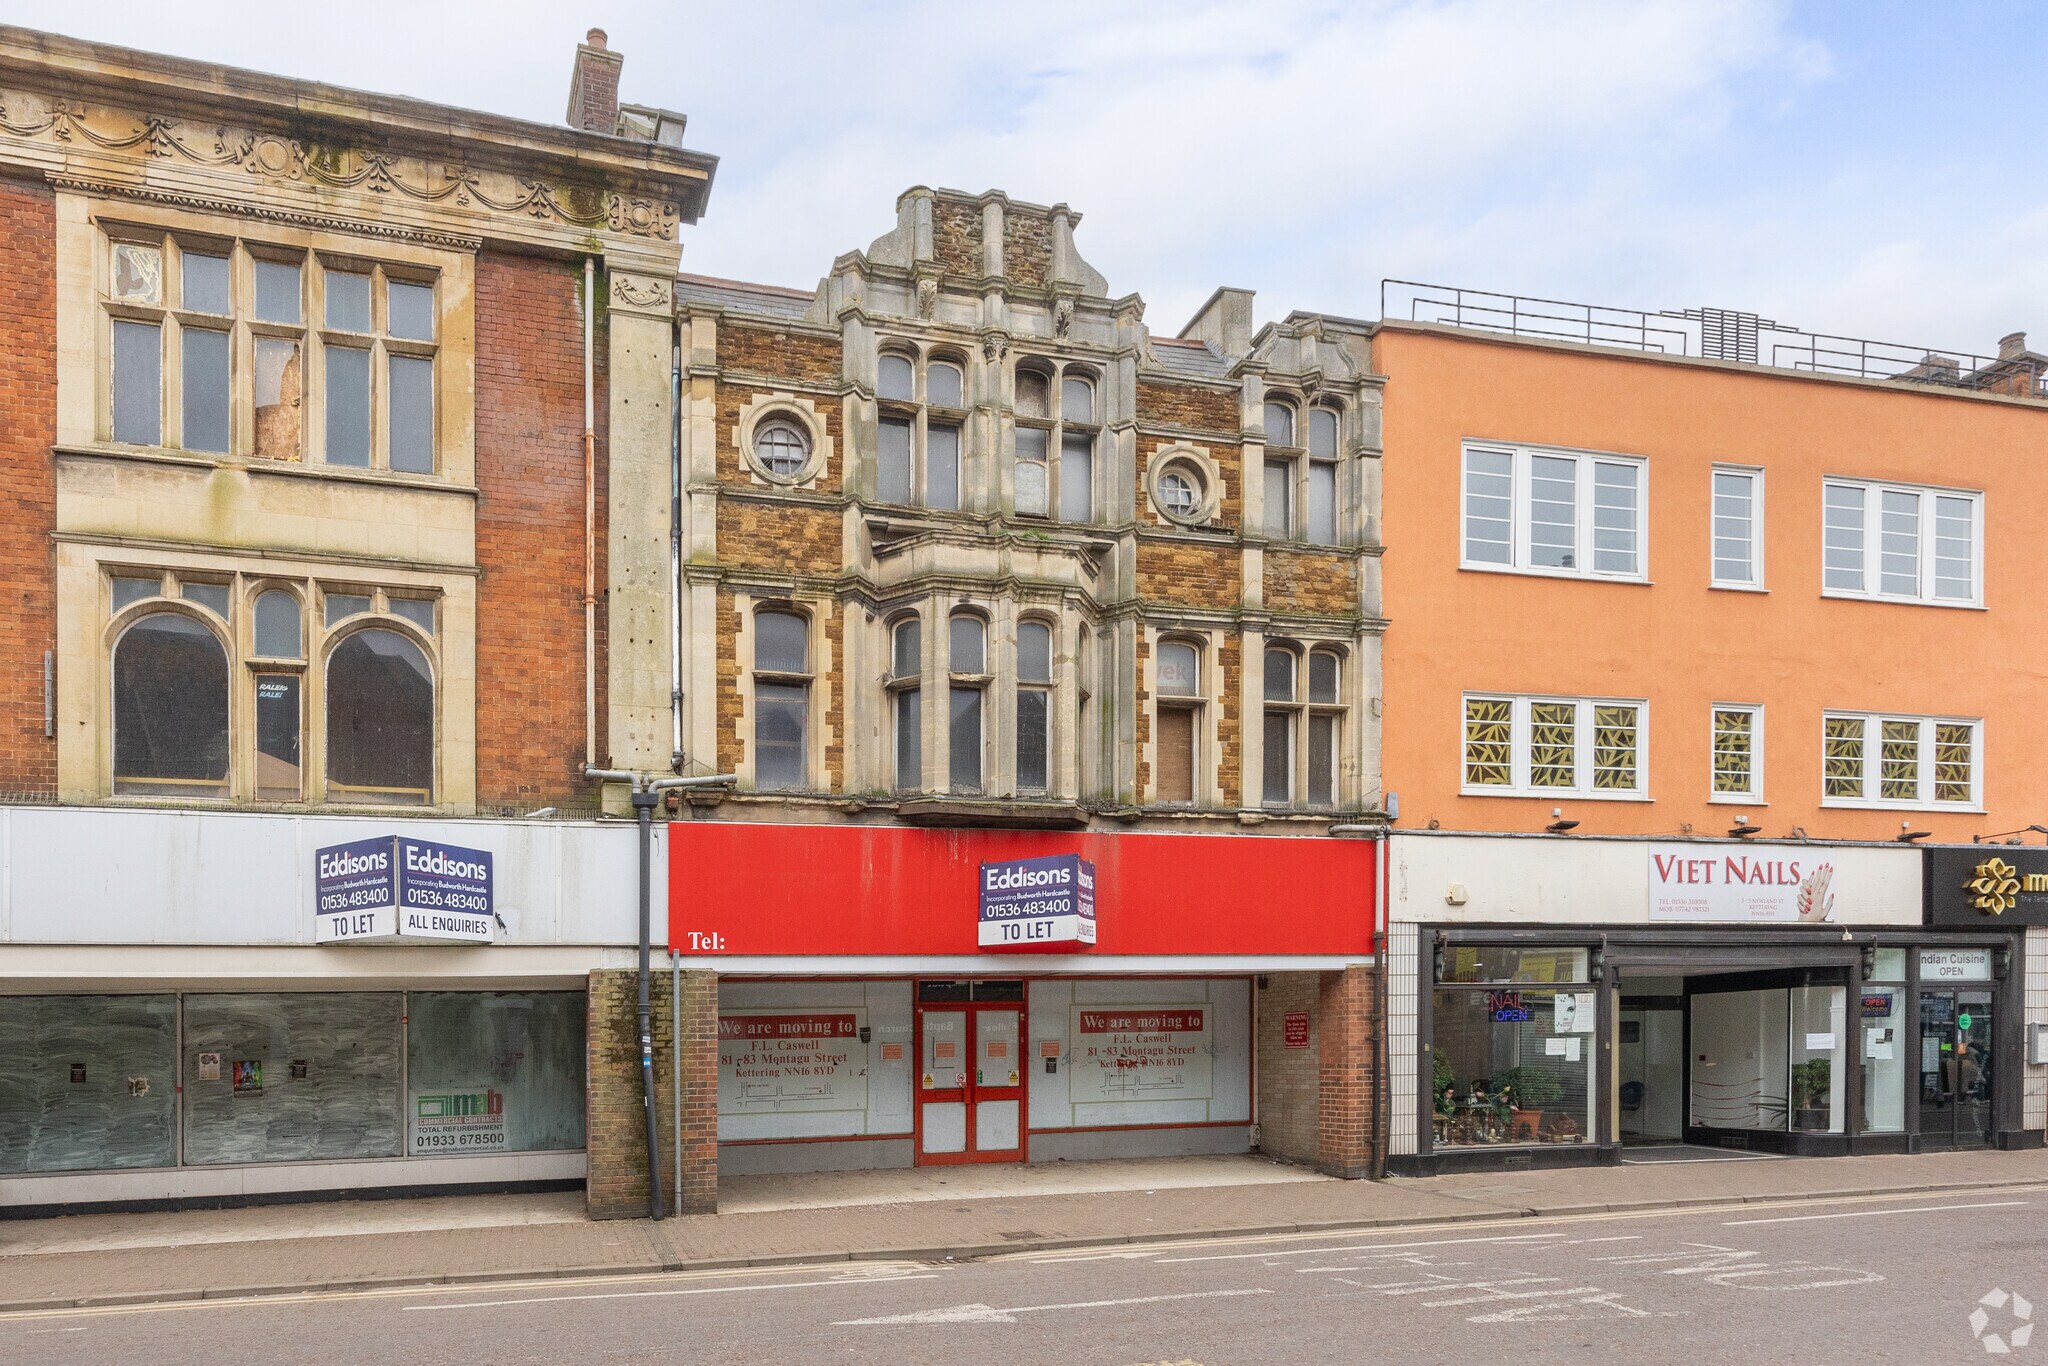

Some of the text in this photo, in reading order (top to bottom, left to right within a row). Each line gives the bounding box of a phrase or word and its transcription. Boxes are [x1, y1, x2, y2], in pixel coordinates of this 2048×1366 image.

[320, 851, 387, 879] Eddisons
[406, 845, 486, 880] Eddisons
[1652, 853, 1801, 886] VIET NAILS
[320, 876, 388, 893] Incorporating Budworth Hardcastle
[407, 876, 487, 893] Incorporating Budworth Hardcastle
[986, 866, 1071, 890] Eddisons
[321, 887, 388, 910] 01536 483400
[408, 888, 487, 911] 01536 483400
[986, 894, 1017, 902] Incorporating
[1017, 891, 1041, 900] Budworth
[1041, 888, 1071, 897] Hardcastle
[986, 903, 1021, 918] 01536
[1022, 898, 1071, 914] 483400
[332, 913, 375, 937] TO LET
[408, 914, 487, 934] ALL ENQUIRIES
[1001, 921, 1054, 940] TO LET
[687, 932, 725, 950] Tel:
[1920, 954, 1985, 964] ndian Cuisine
[1939, 967, 1964, 976] OPEN
[1865, 998, 1886, 1006] OPEN
[1083, 1014, 1200, 1029] We are moving to
[1495, 1010, 1528, 1021] OPEN
[718, 1019, 853, 1035] We are moving to
[751, 1040, 819, 1051] F.L. Caswell
[1113, 1033, 1171, 1044] F.L. Caswell
[1087, 1047, 1098, 1056] 81
[1122, 1046, 1164, 1056] Montagu
[1167, 1045, 1196, 1055] Street
[721, 1055, 733, 1065] 81
[761, 1053, 810, 1065] Montagu
[814, 1052, 847, 1063] Street
[1167, 1058, 1184, 1066] 8YD
[735, 1066, 834, 1078] Kettering NN16 8YD
[419, 1115, 504, 1126] COMMERCIAL CONTRACTS
[443, 1124, 504, 1132] REFURBISHMENT
[417, 1133, 505, 1147] 01933 678500
